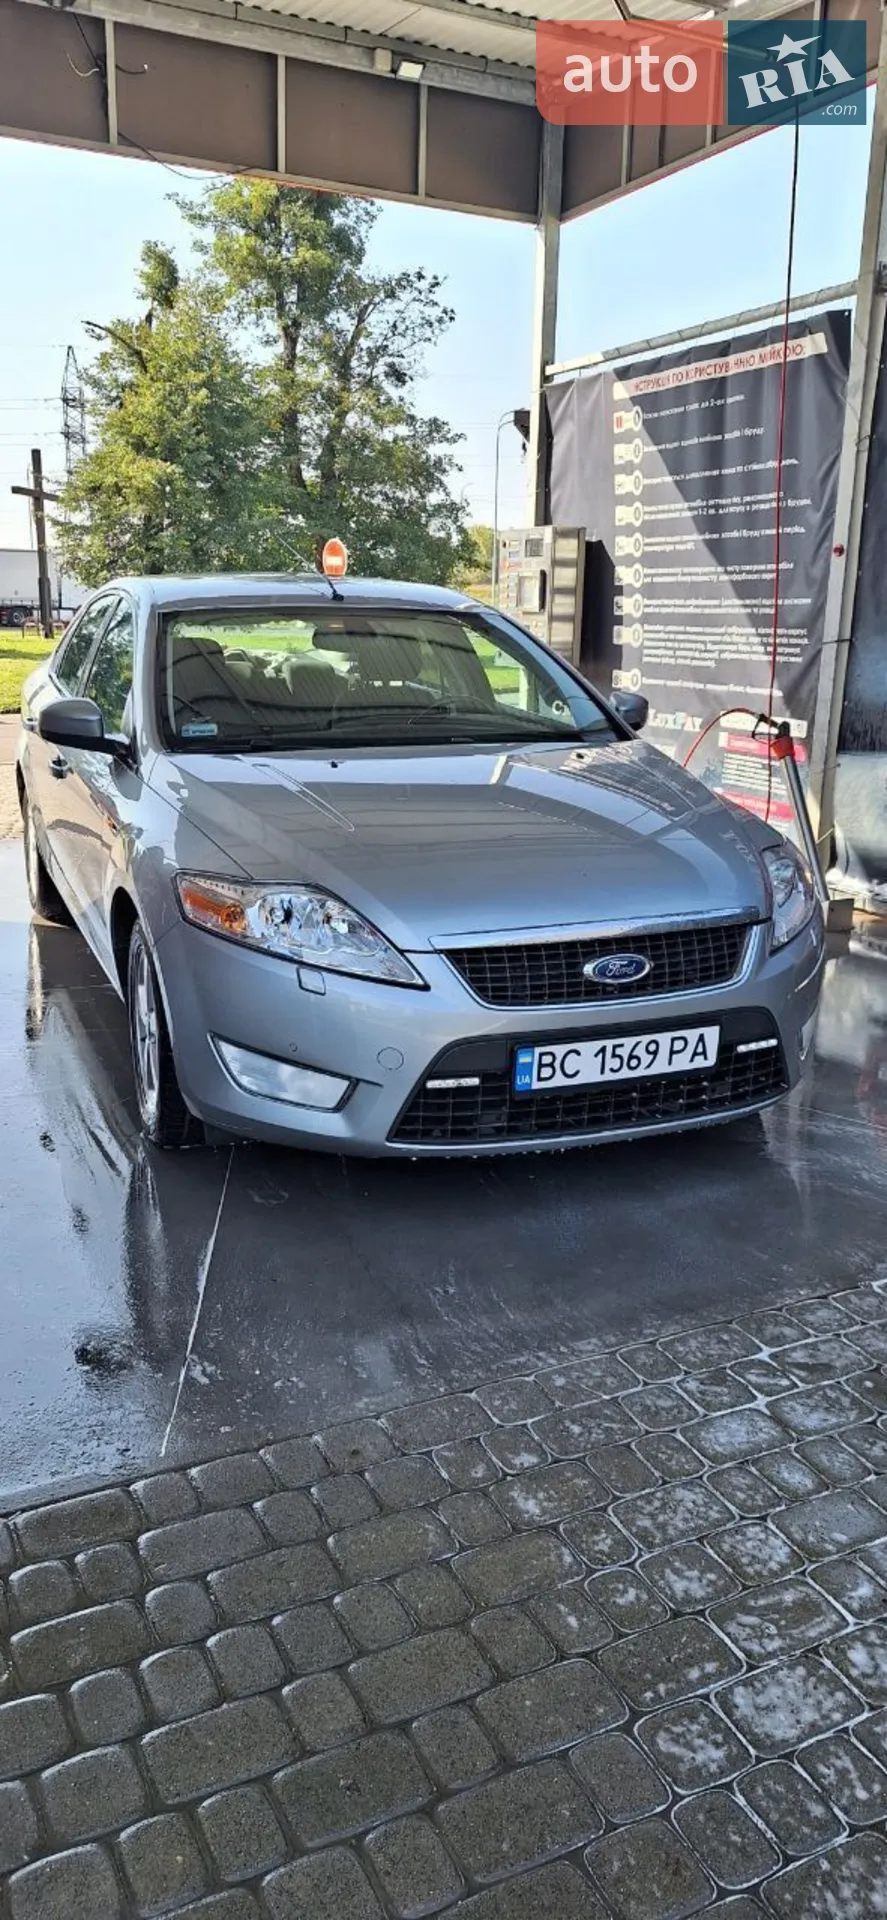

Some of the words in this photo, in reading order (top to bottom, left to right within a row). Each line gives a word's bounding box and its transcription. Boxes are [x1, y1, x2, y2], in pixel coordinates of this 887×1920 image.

[605, 959, 636, 977] Ford
[536, 1049, 582, 1083] BC
[593, 1038, 661, 1076] 1569
[667, 1032, 709, 1067] PA
[516, 1074, 532, 1086] UA
